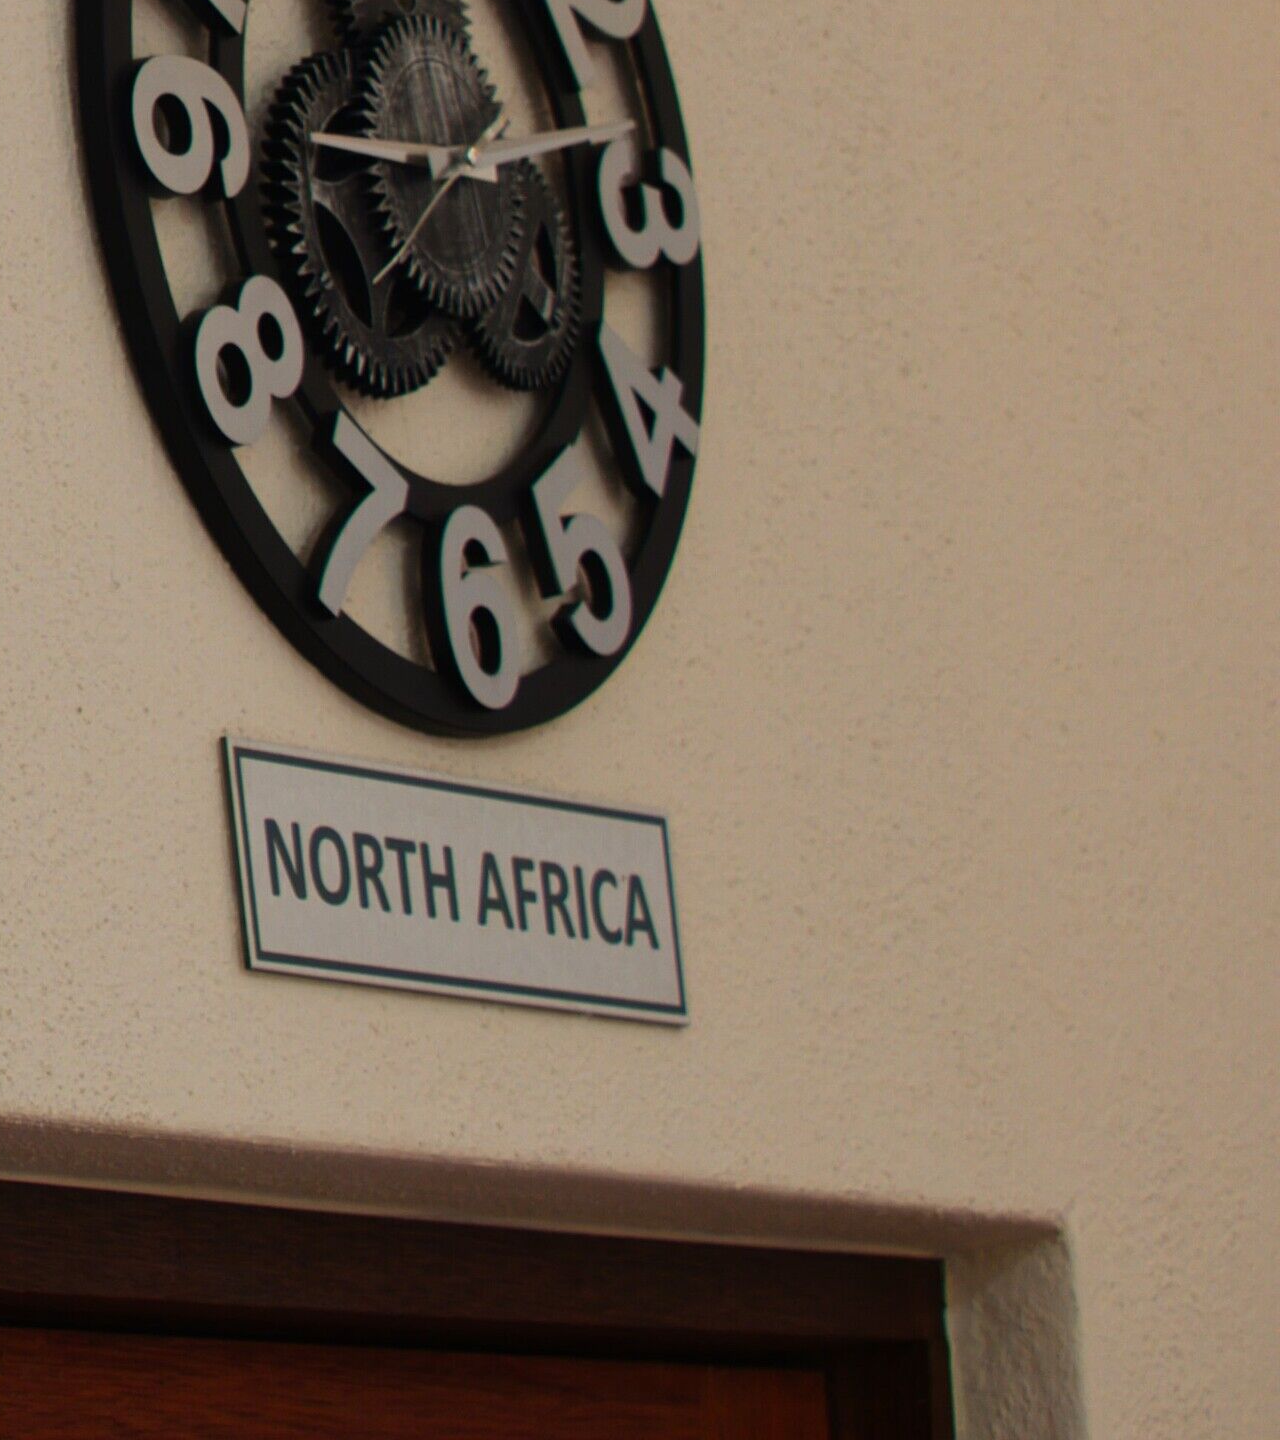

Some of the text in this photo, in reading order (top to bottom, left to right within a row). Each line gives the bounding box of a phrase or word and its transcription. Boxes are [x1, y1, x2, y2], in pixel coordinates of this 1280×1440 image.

[133, 54, 249, 198] 9
[599, 144, 700, 268] 3
[195, 274, 304, 445] 8
[599, 320, 699, 497] 4
[318, 409, 409, 616] 7
[534, 445, 630, 656] 5
[441, 504, 519, 709] 6
[264, 819, 659, 950] NORTH AFRICA
